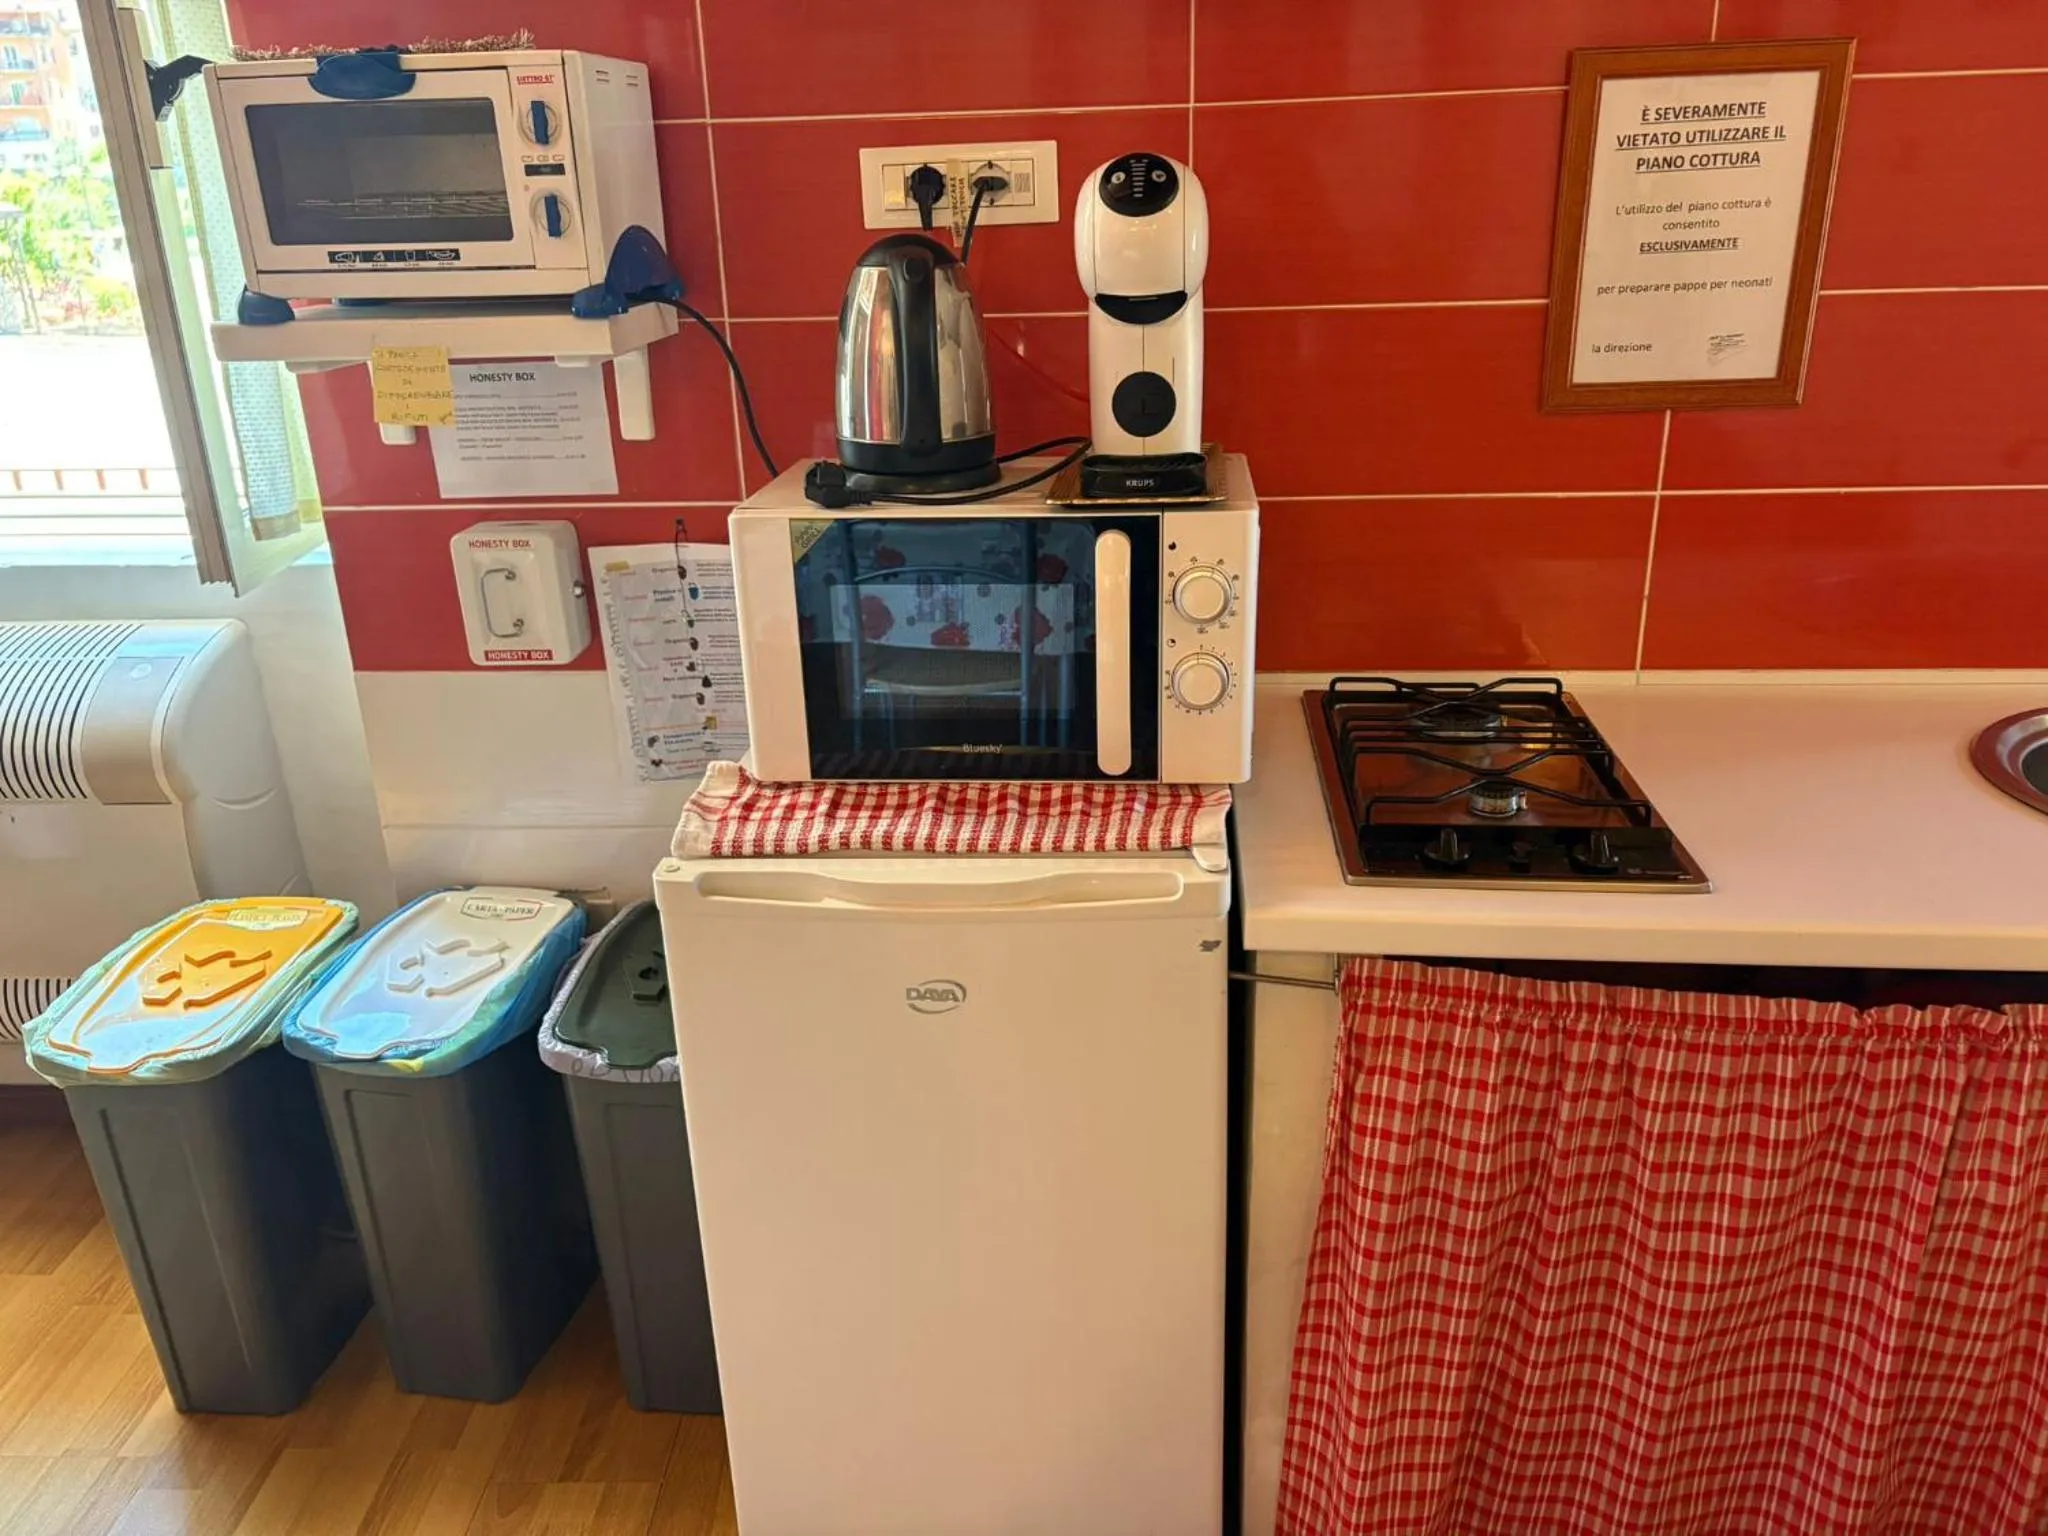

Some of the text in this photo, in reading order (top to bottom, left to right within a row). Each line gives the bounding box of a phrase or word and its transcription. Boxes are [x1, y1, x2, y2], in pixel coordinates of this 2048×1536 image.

[1642, 101, 1767, 122] È SEVERAMENTE
[1616, 126, 1787, 149] VIETATO UTILIZZARE IL
[1635, 151, 1761, 172] PIANO COTTURA
[1665, 201, 1684, 215] del
[1688, 200, 1720, 217] piano
[1721, 197, 1762, 212] cottura
[1662, 217, 1720, 231] consentito
[1639, 237, 1740, 253] ESCLUSIVAMENTE
[1597, 275, 1773, 297] per preparare pappe per neonati
[1591, 341, 1653, 354] la direzione
[469, 372, 536, 383] HONESTY BOX
[1125, 479, 1155, 488] KRUPS
[468, 538, 533, 549] HONESTY BOX
[487, 650, 550, 661] HONESTY BOX
